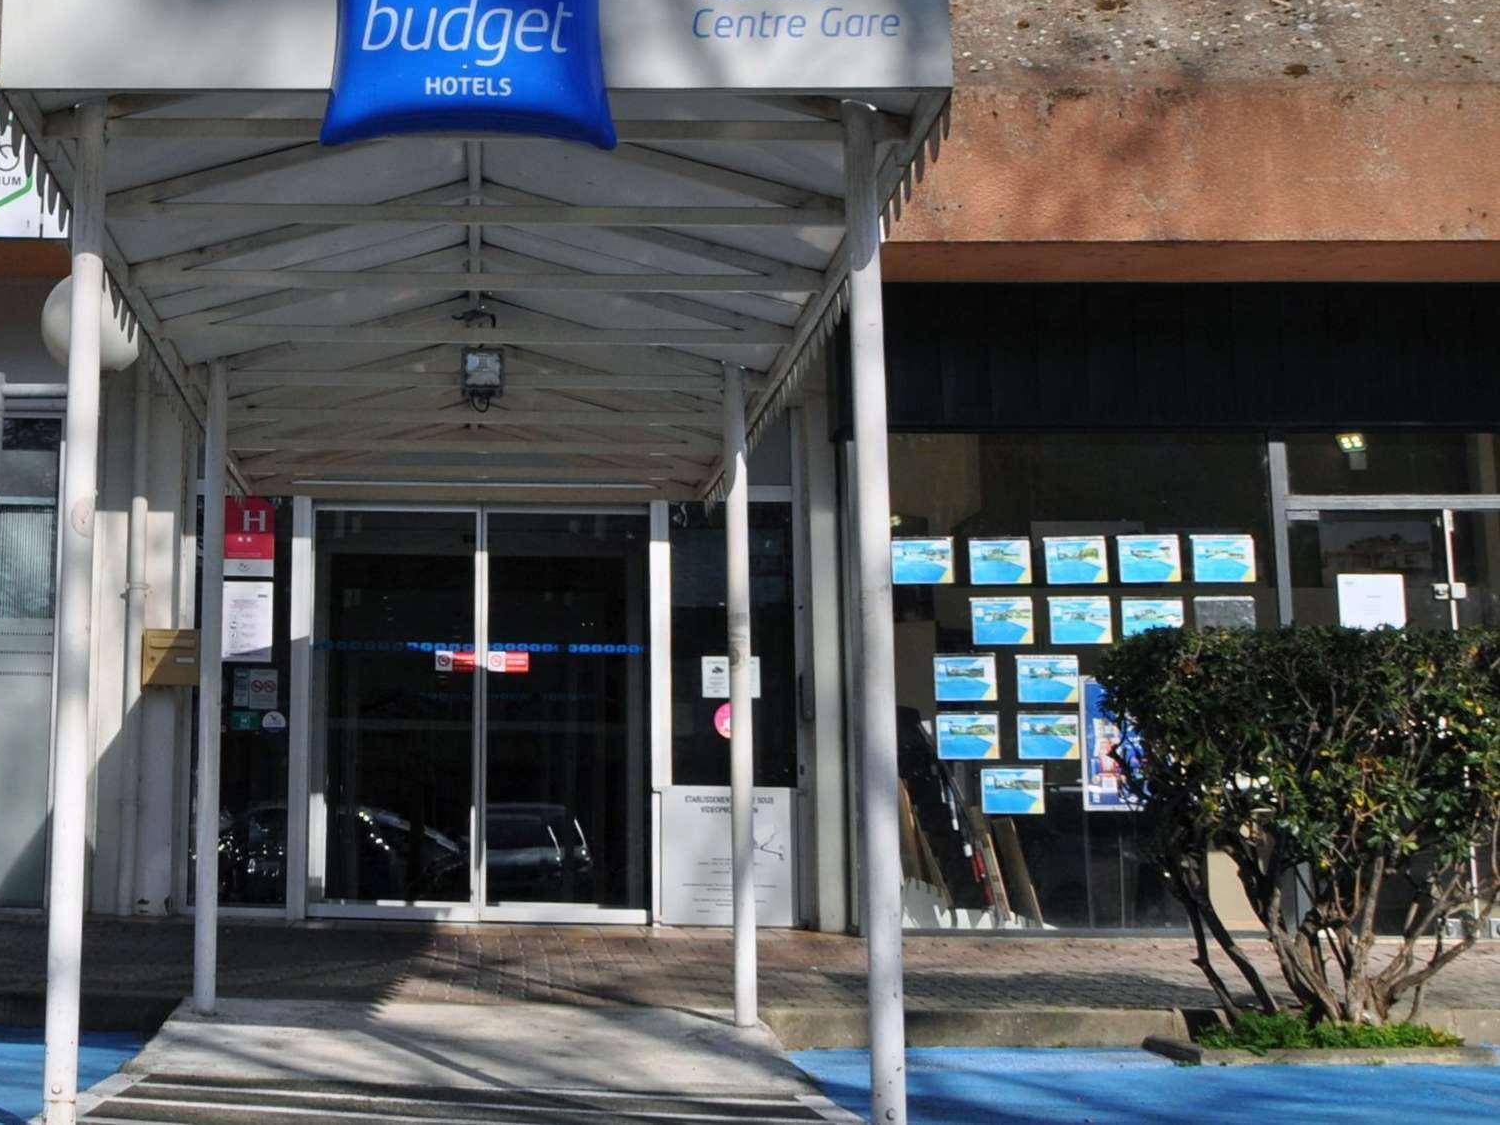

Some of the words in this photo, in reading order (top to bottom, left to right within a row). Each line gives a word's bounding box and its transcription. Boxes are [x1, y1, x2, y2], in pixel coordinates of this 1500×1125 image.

[692, 8, 806, 38] Centre
[820, 7, 900, 37] Gare
[425, 76, 512, 96] HOTELS
[243, 509, 266, 532] H
